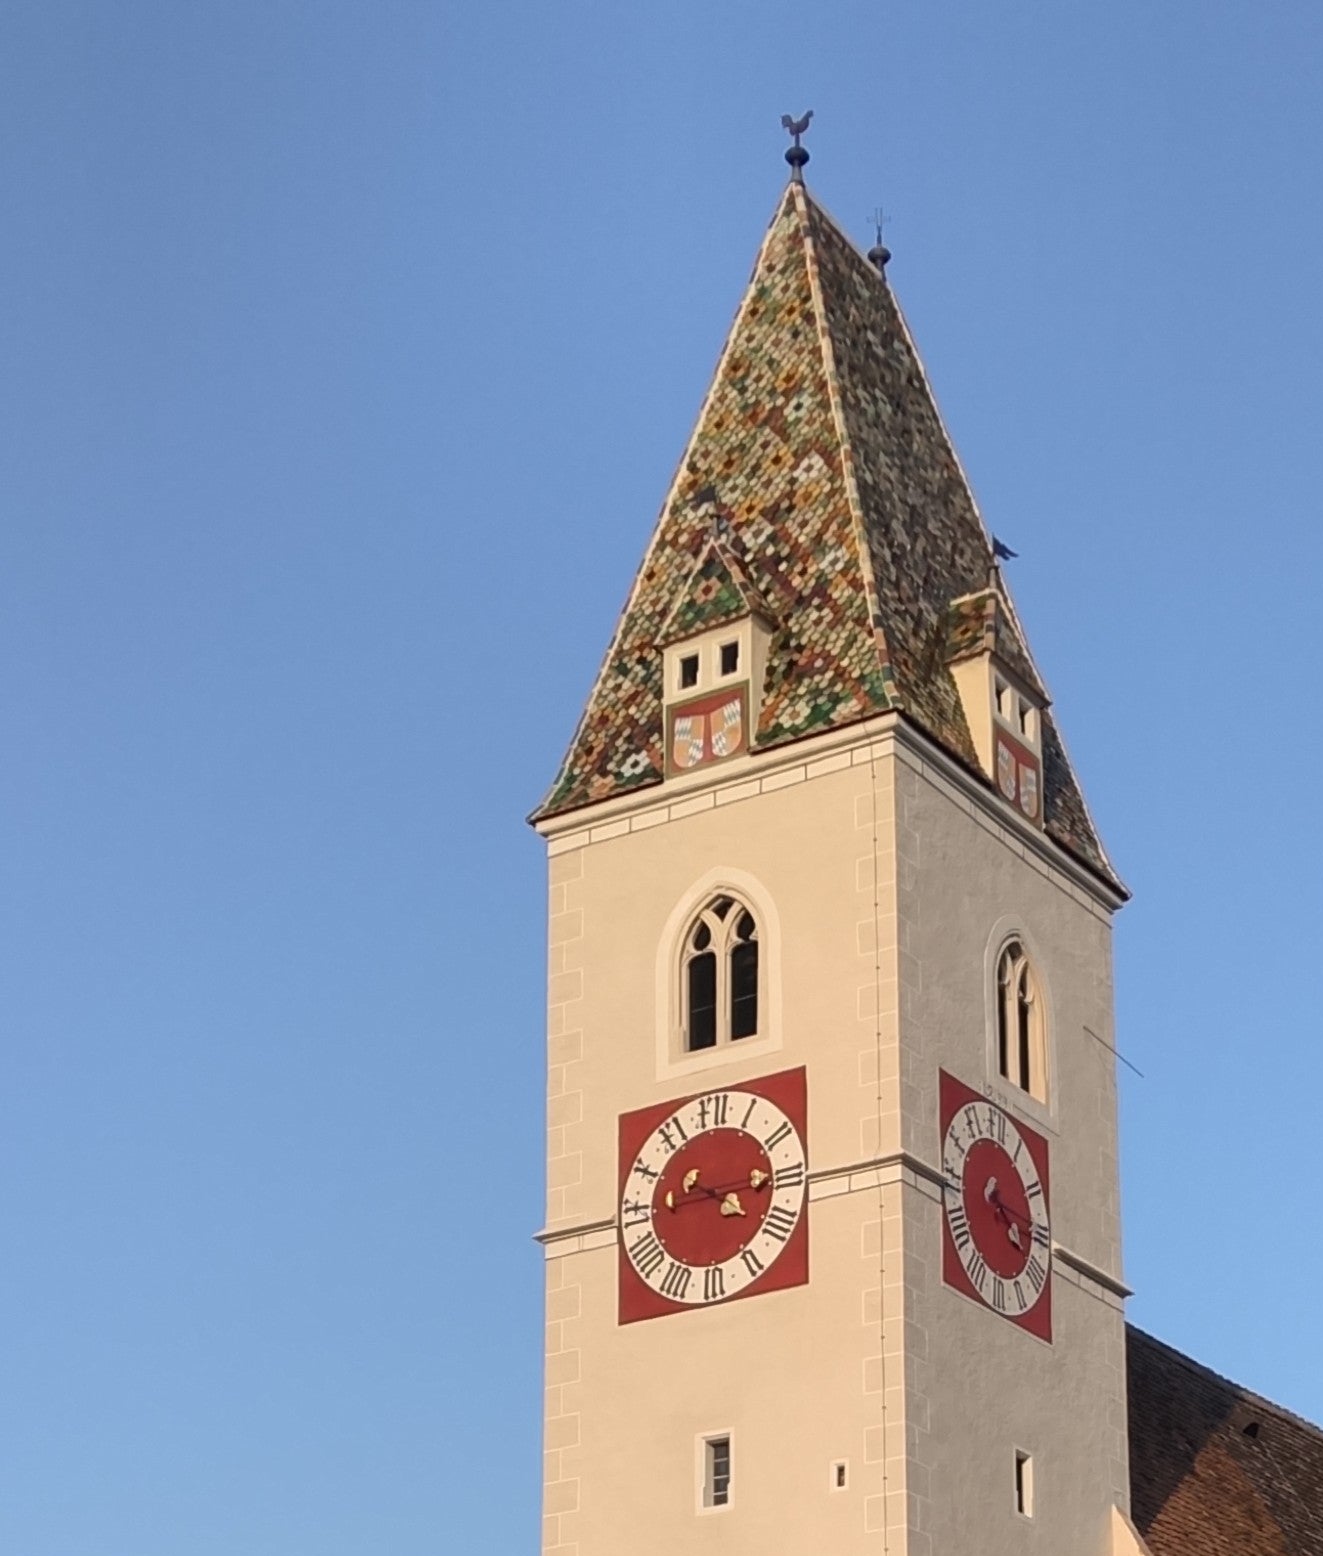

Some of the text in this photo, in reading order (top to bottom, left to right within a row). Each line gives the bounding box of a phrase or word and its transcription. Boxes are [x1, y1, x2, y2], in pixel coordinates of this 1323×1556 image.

[695, 1093, 729, 1129] XII
[741, 1098, 757, 1129] I
[658, 1116, 688, 1155] XI
[764, 1121, 793, 1152] II
[634, 1157, 659, 1184] X
[774, 1161, 804, 1191] III
[762, 1205, 798, 1243] IIII
